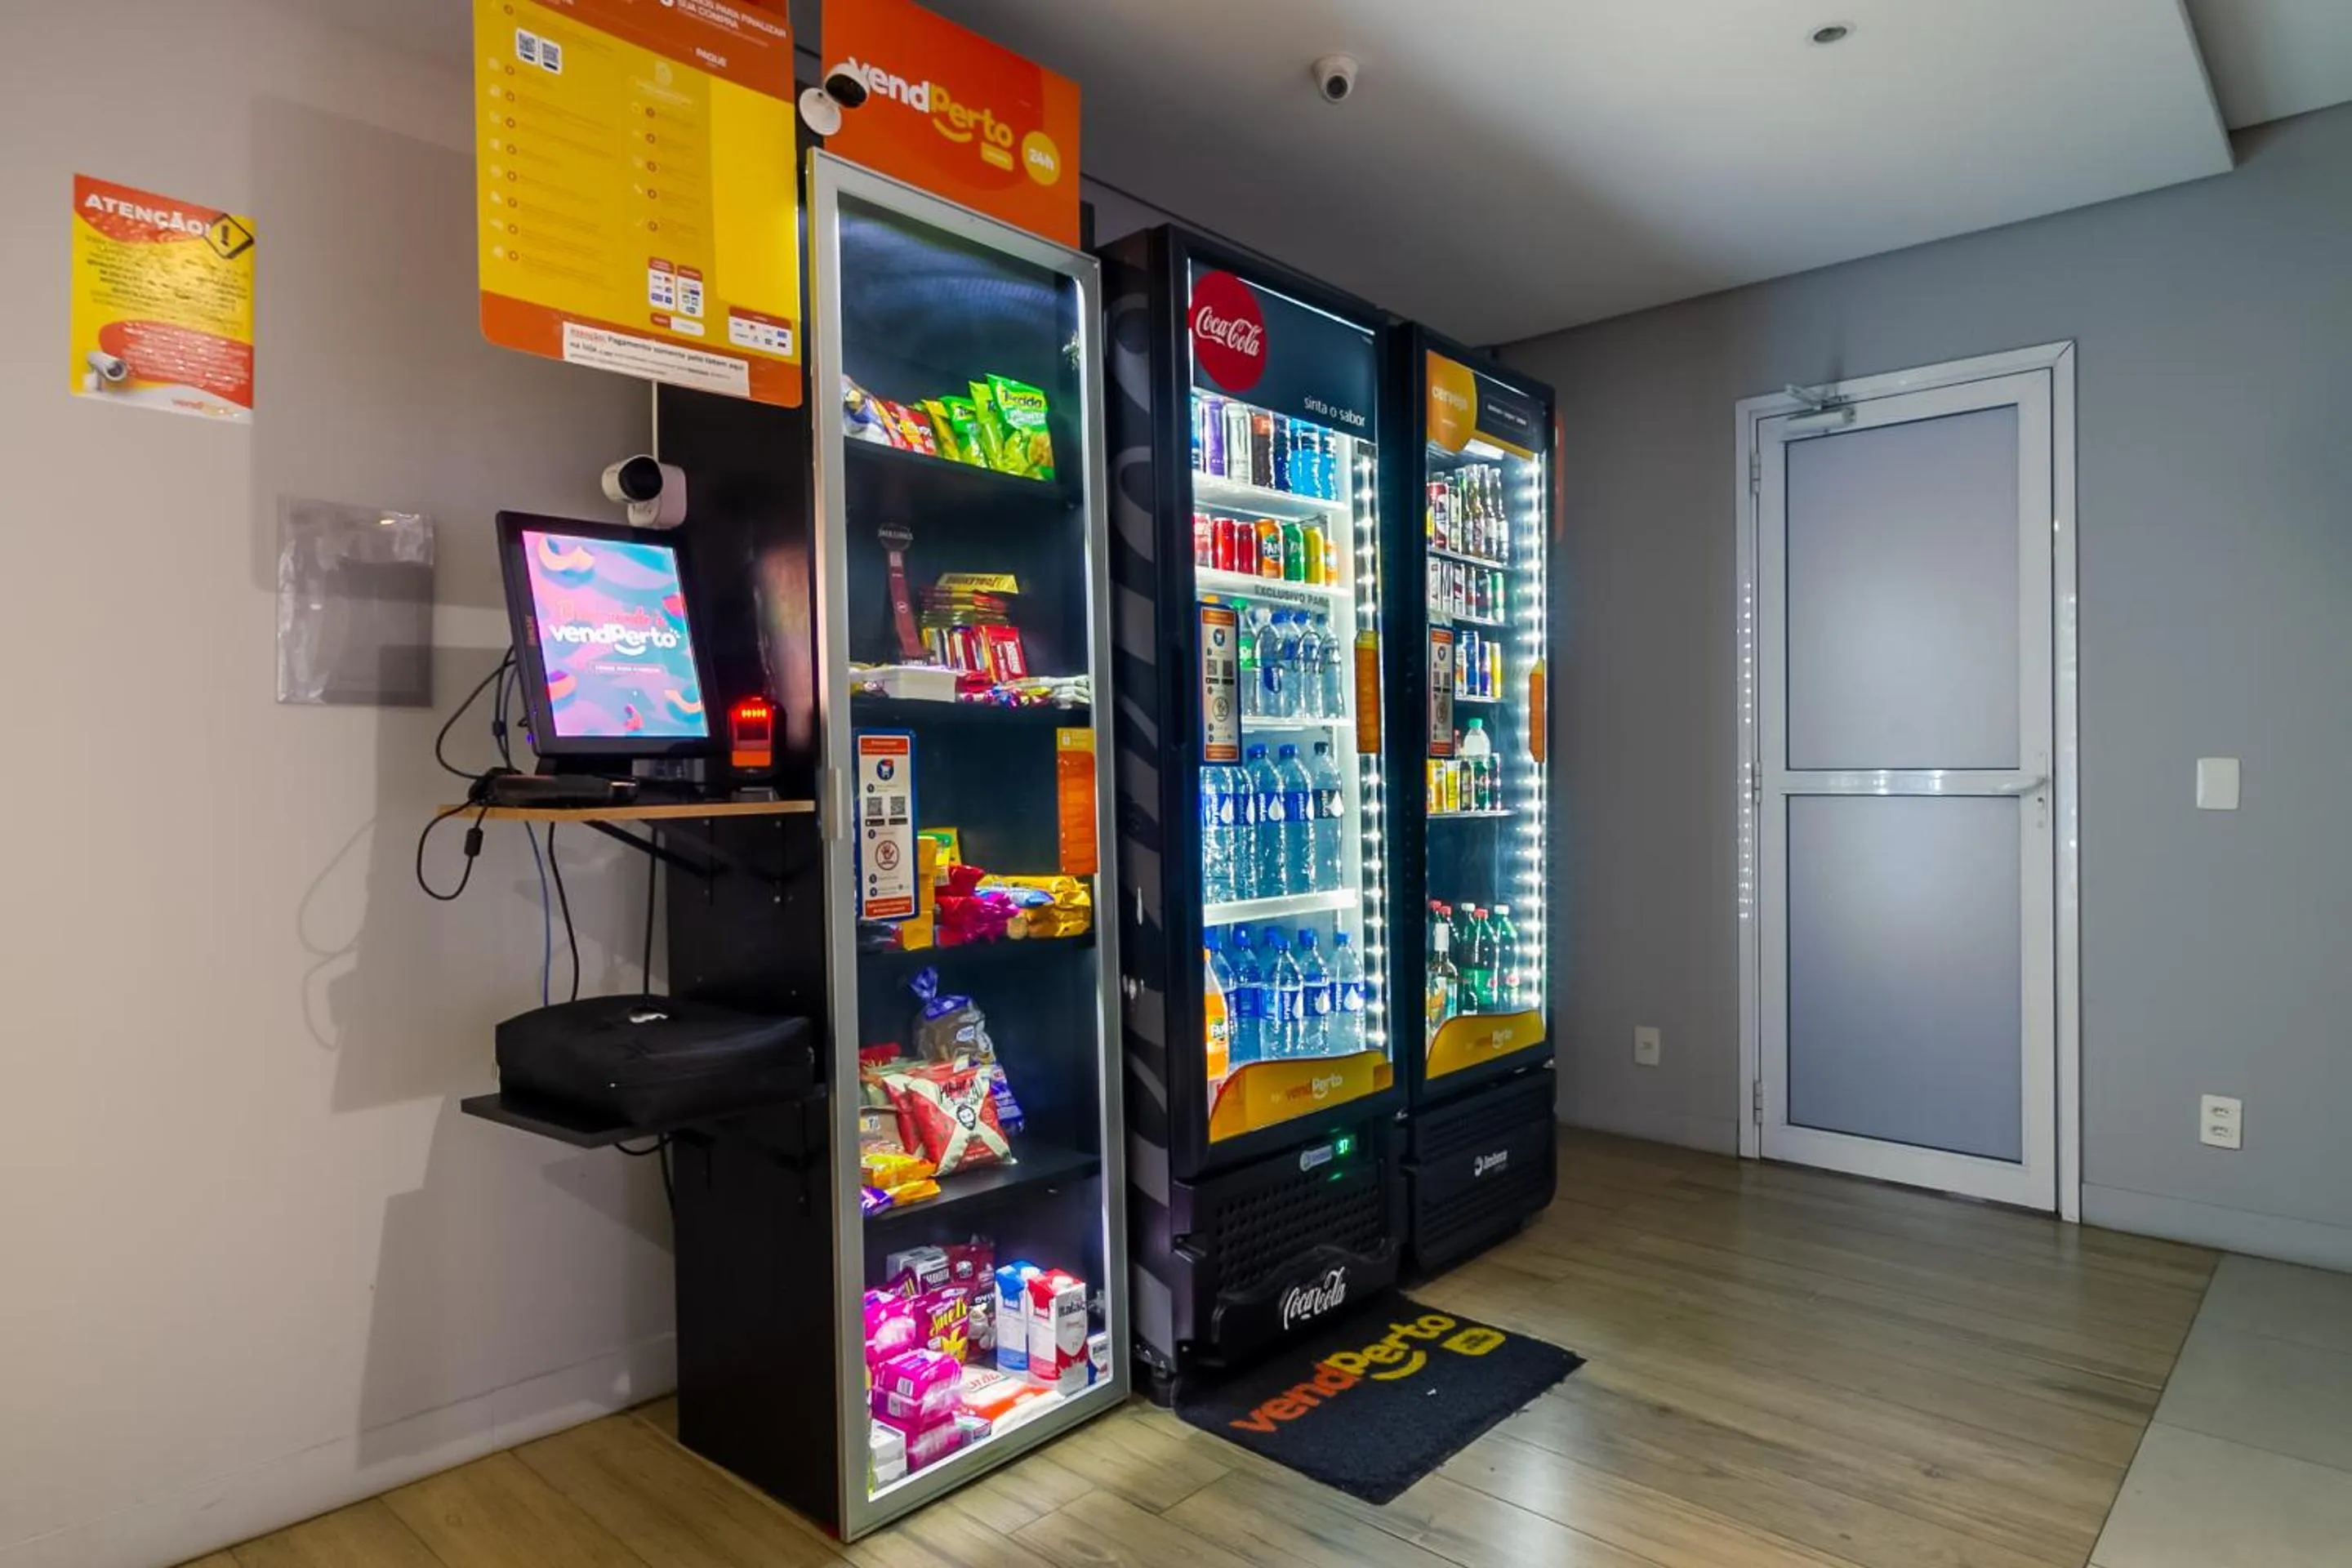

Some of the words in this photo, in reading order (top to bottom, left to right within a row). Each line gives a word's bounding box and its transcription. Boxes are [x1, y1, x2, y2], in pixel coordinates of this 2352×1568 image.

[1196, 305, 1263, 357] Coca-Cola
[1303, 396, 1328, 416] sinta
[1329, 406, 1338, 418] o
[1339, 409, 1366, 427] sabor
[1254, 585, 1306, 603] EXCLUSIVO
[550, 623, 677, 648] vendPerto
[1283, 1266, 1347, 1330] Coca-Cola
